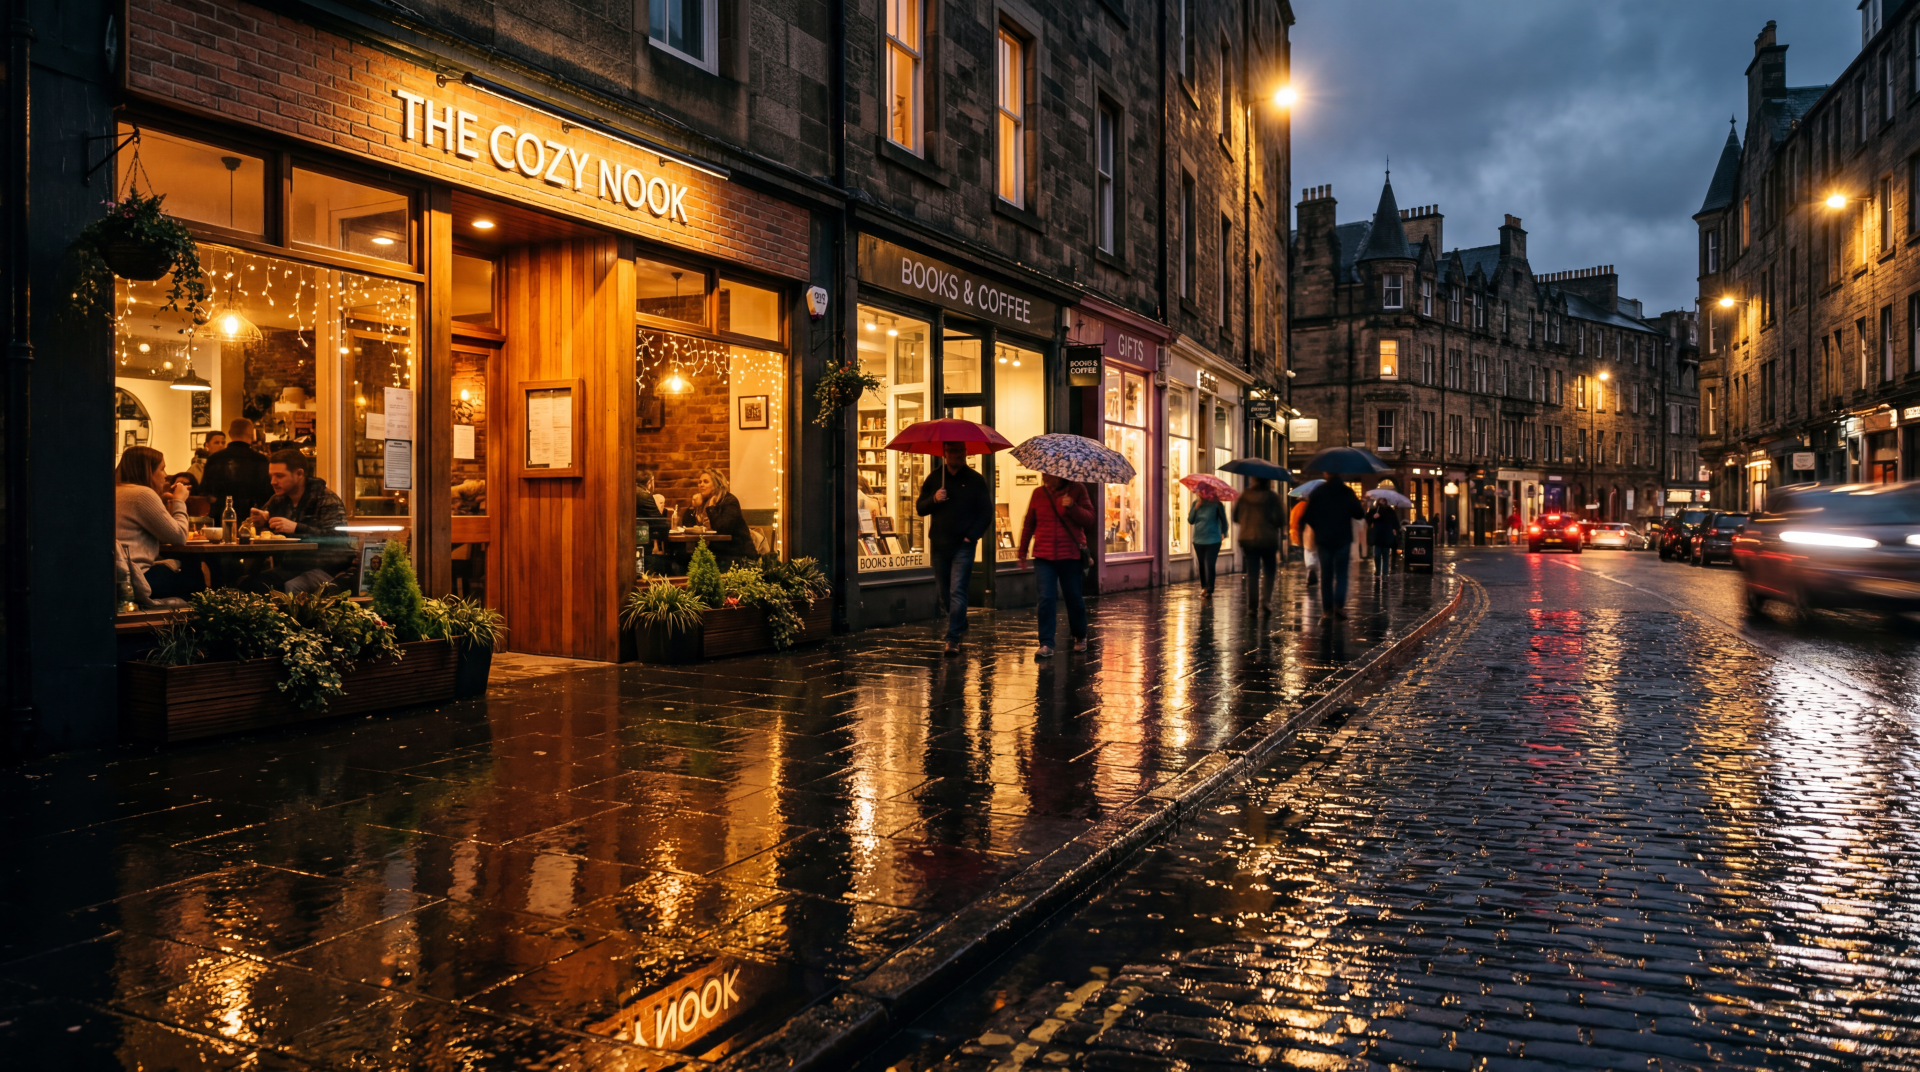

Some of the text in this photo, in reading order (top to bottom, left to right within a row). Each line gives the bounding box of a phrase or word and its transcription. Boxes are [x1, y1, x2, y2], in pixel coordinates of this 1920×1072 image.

[396, 88, 688, 224] THE COZY NOOK
[901, 256, 1031, 324] BOOKS & COFFEE
[1117, 333, 1144, 362] GIFTS
[889, 556, 894, 567] &
[895, 554, 923, 567] COFFEE
